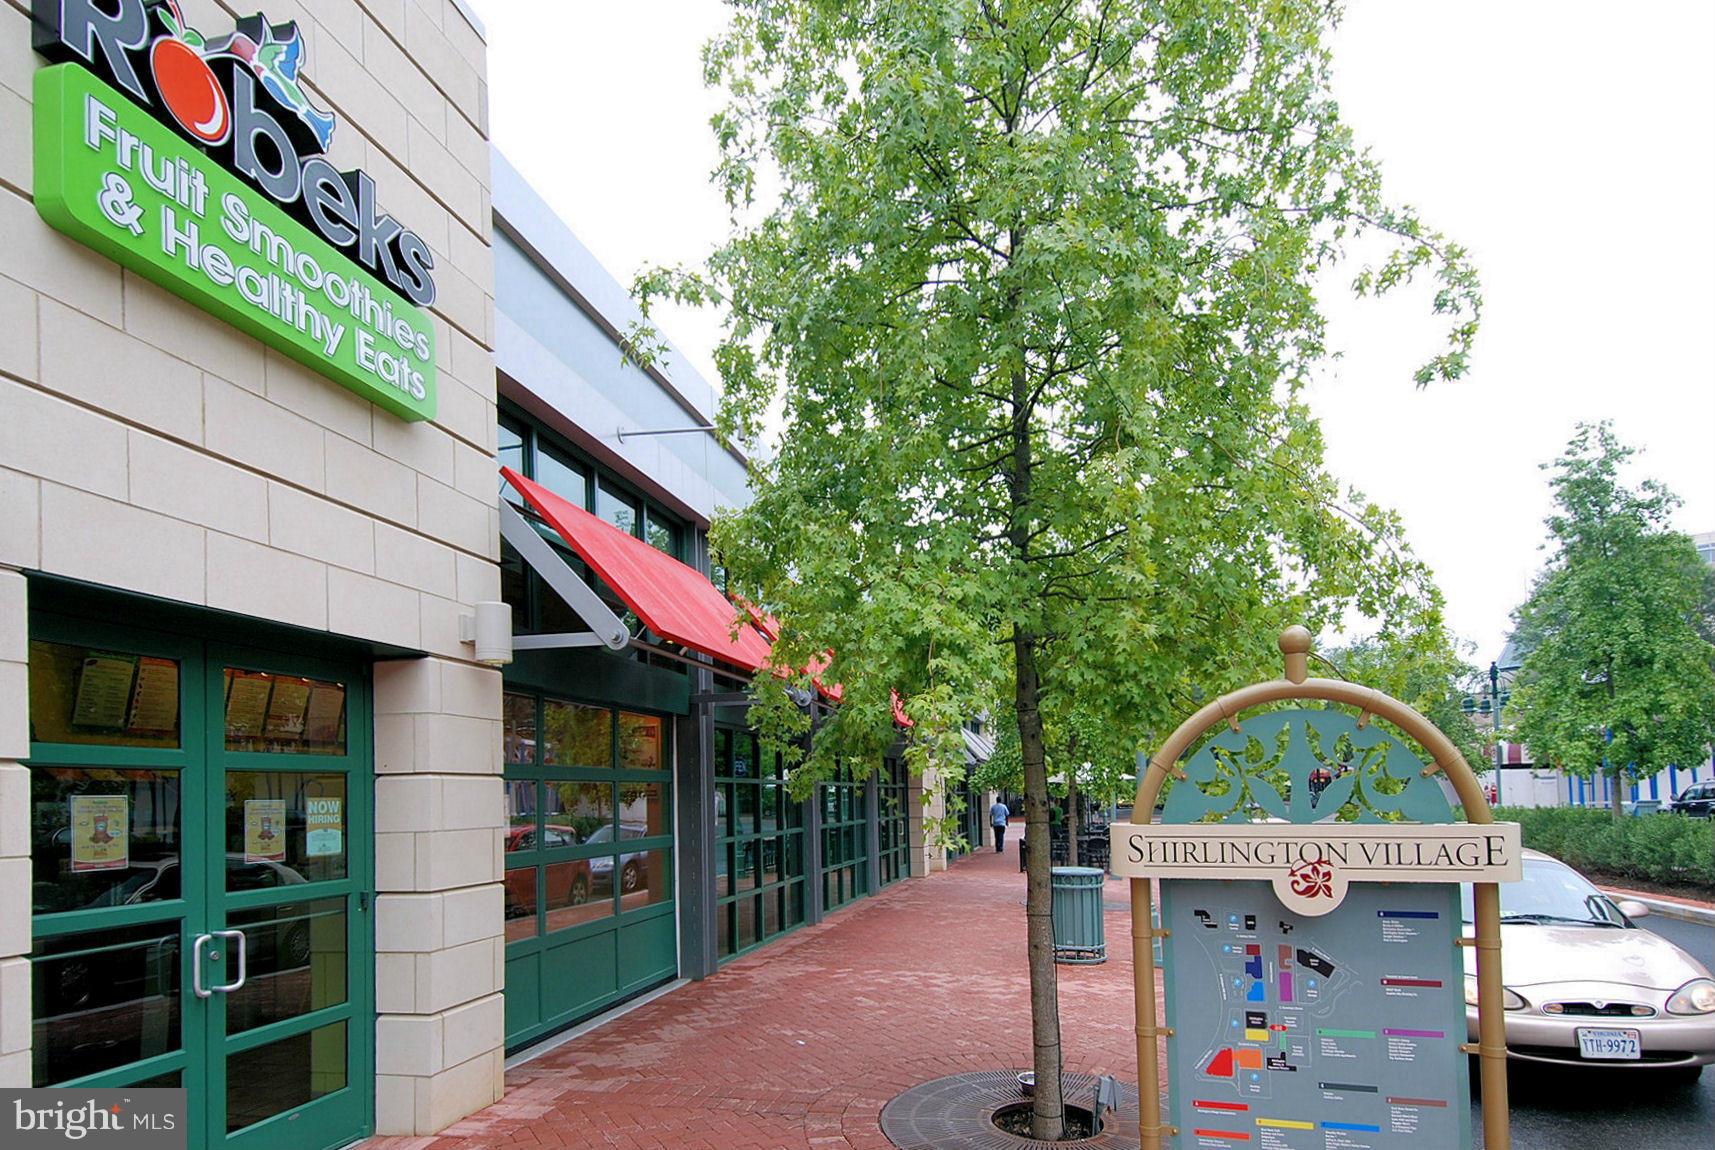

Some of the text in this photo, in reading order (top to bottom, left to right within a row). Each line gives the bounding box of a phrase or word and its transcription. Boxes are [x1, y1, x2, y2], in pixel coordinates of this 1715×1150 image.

[85, 93, 431, 362] Fruit Smoothies
[98, 171, 427, 400] & Healthy Eats
[307, 814, 341, 825] HIRING
[308, 800, 341, 814] NOW
[1357, 835, 1509, 867] VILLAGE
